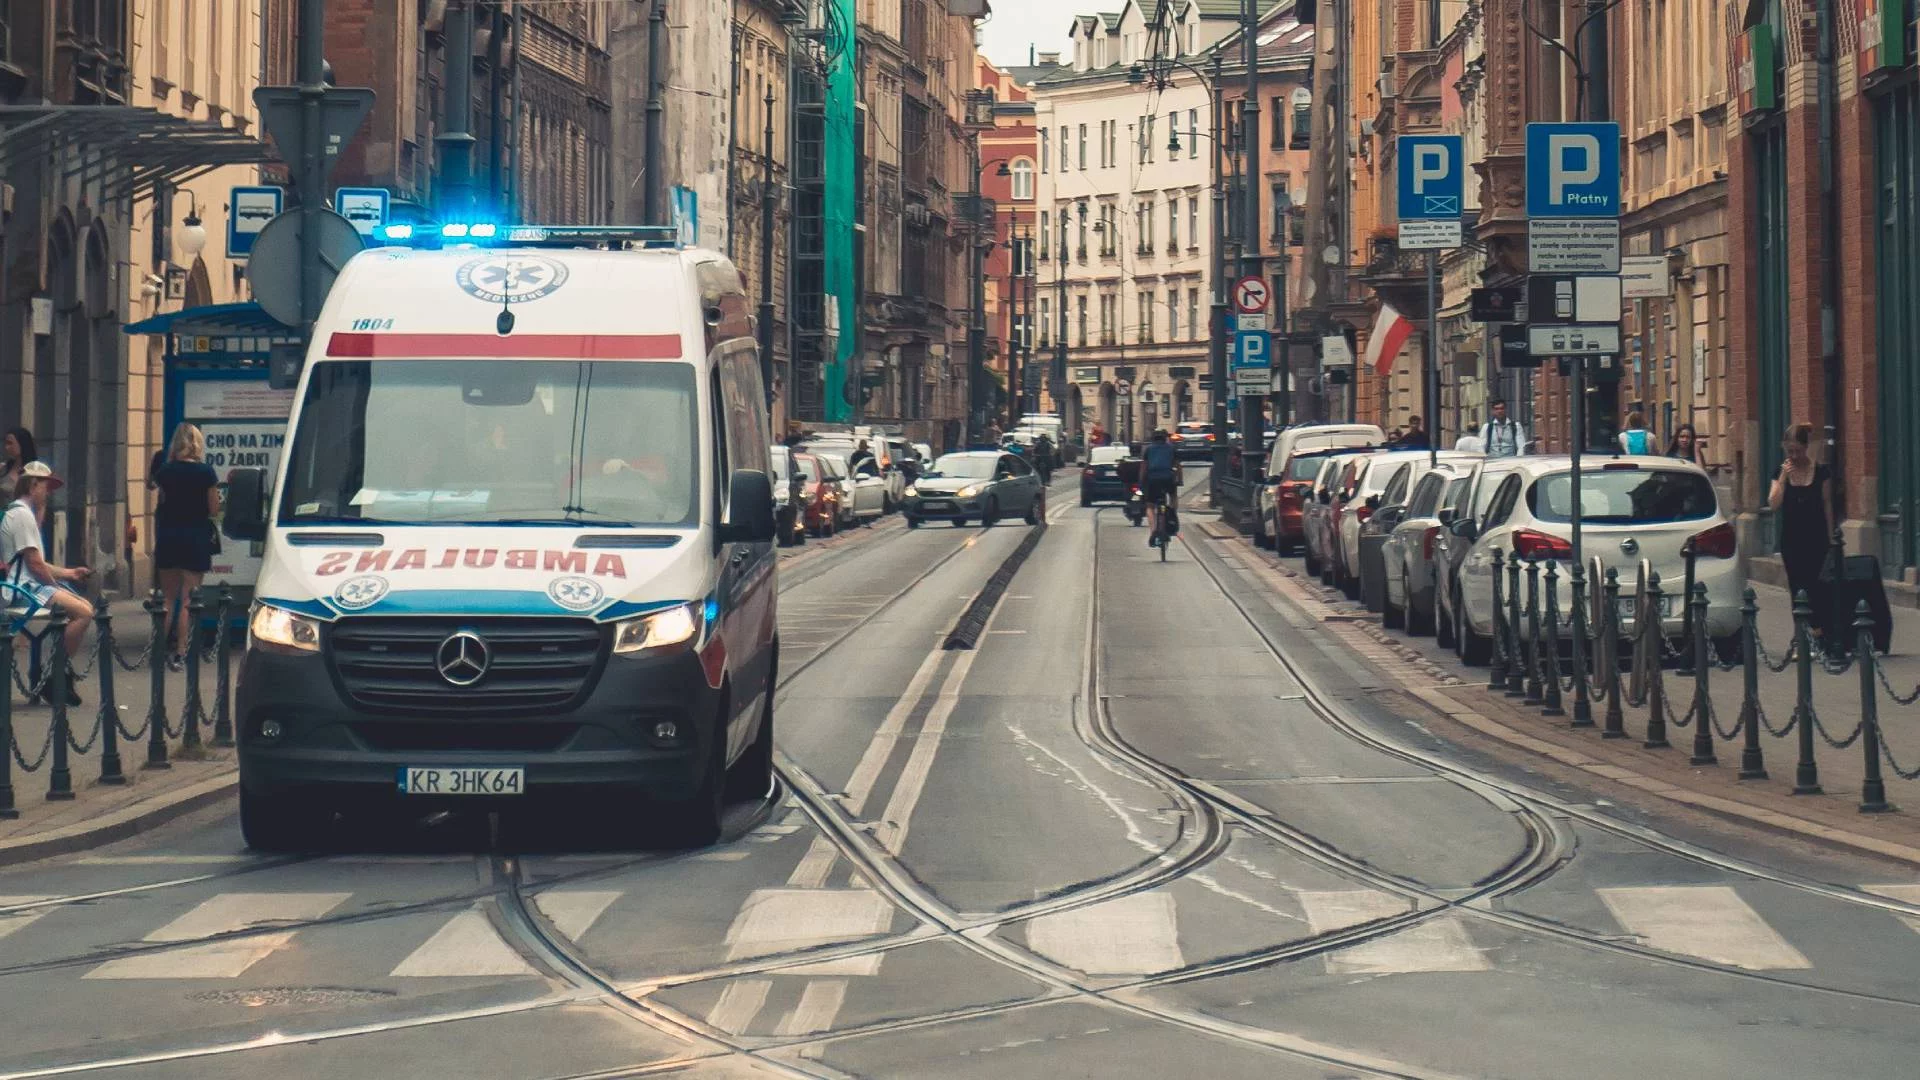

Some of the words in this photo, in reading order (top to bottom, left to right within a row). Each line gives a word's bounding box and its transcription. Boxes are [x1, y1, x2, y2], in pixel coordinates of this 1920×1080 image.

[1413, 144, 1449, 194] P
[1548, 134, 1600, 205] P
[1567, 193, 1608, 206] Płatny
[352, 318, 395, 331] 1804
[1243, 336, 1263, 363] P
[239, 434, 257, 448] NA
[206, 453, 225, 466] DO
[228, 449, 269, 466] ŻABKI
[411, 771, 440, 792] KR
[449, 771, 519, 792] 3HK64
